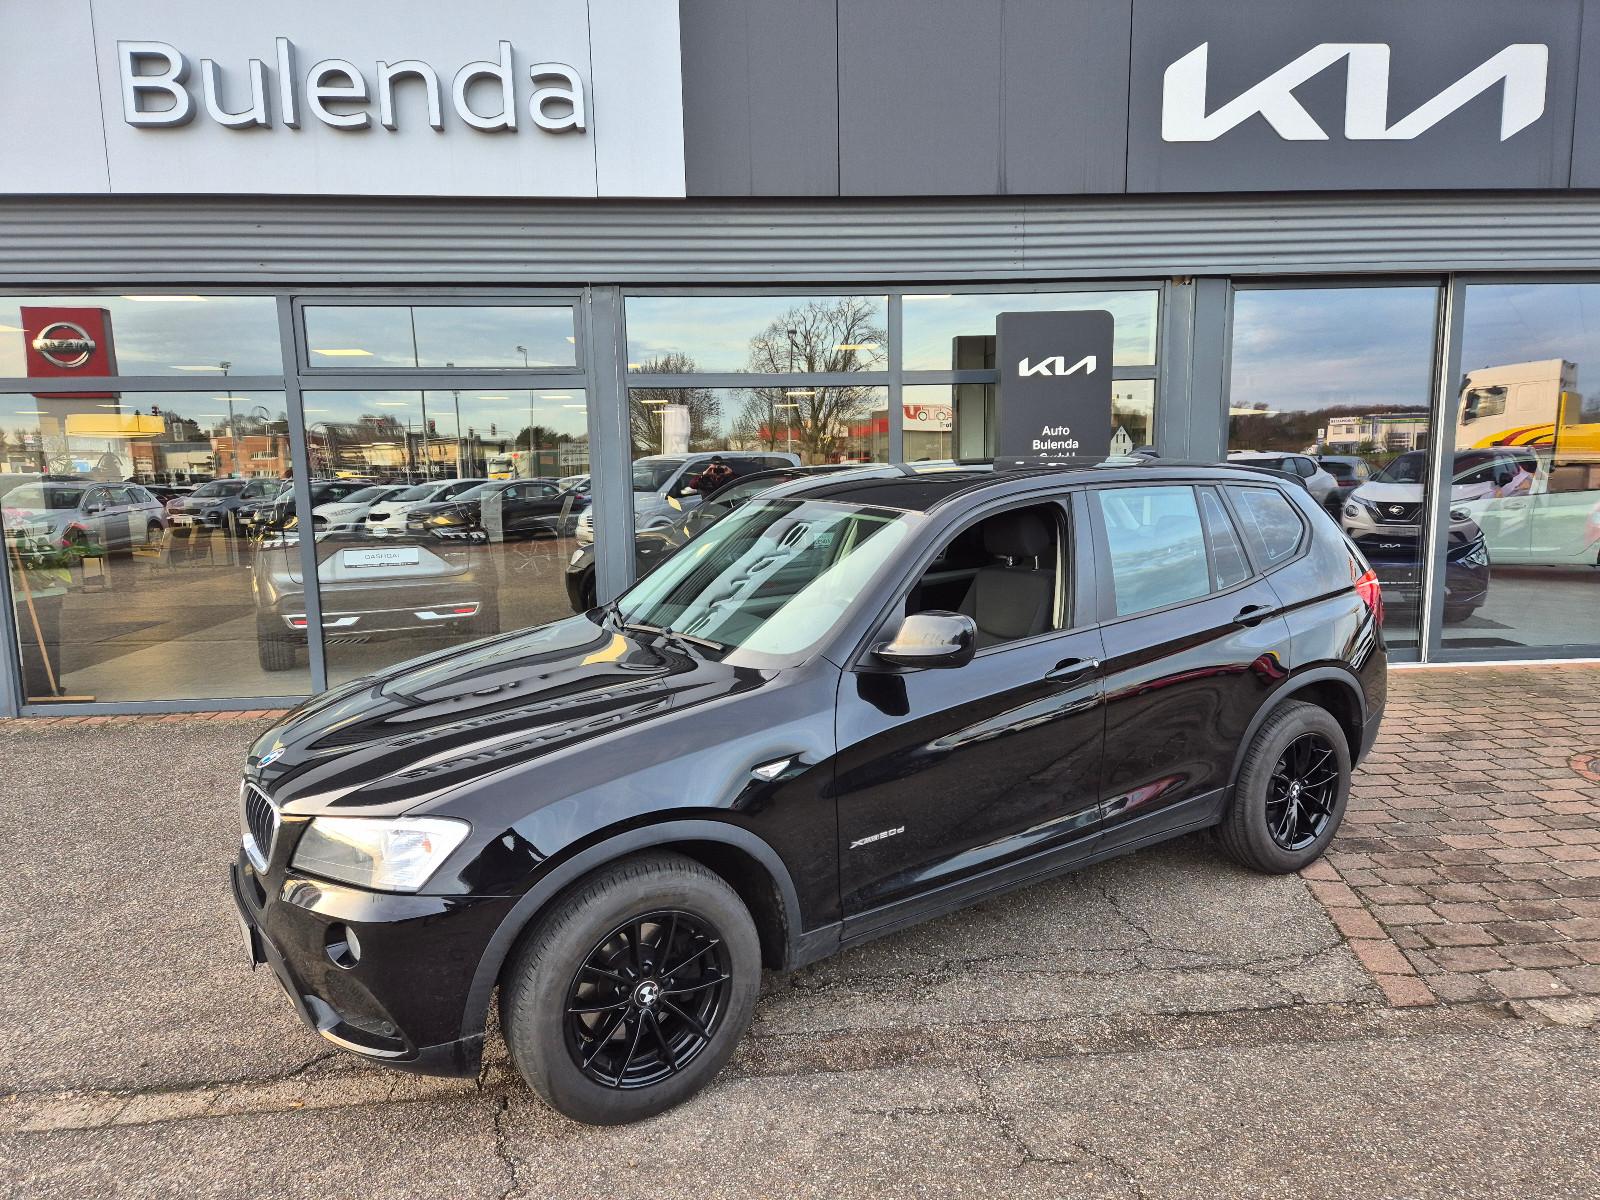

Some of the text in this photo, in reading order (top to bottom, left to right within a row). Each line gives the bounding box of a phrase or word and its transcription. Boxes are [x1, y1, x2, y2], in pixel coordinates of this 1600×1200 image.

[116, 37, 587, 133] Bulenda
[1161, 41, 1549, 142] KIA
[1018, 355, 1097, 377] KIA
[1042, 425, 1070, 436] Auto
[1032, 438, 1079, 450] Bulenda
